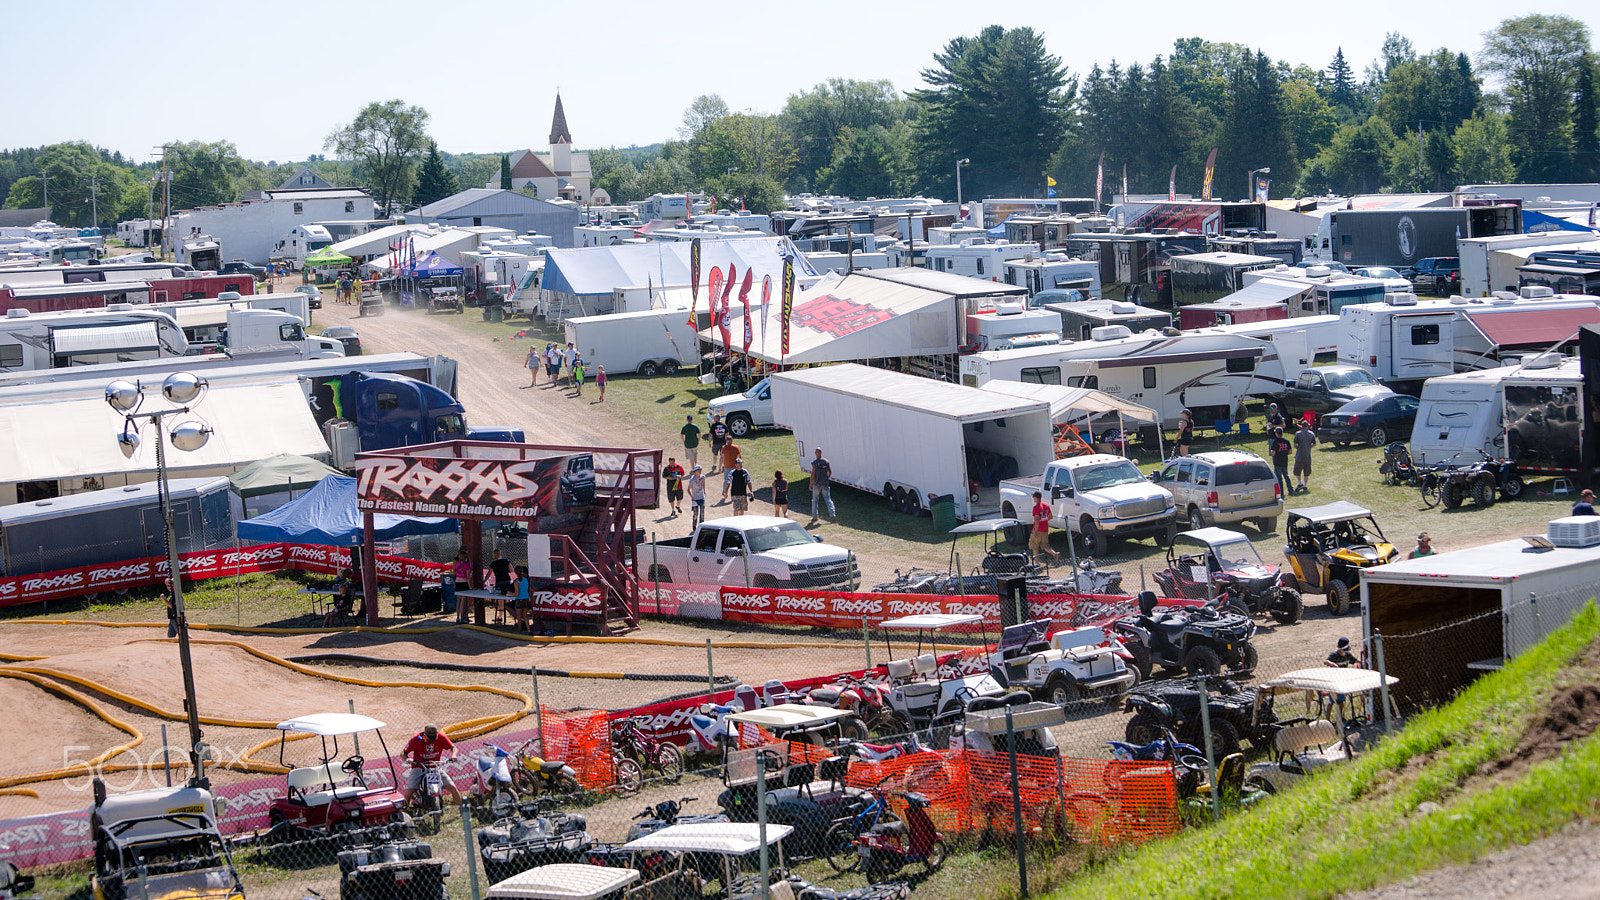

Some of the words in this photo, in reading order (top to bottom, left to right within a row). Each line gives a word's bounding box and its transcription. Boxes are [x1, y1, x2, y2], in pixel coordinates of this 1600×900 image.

[1101, 384, 1120, 392] Laredo
[356, 457, 540, 504] TRAXXAS
[357, 498, 374, 509] The
[375, 500, 414, 511] Fastest
[415, 502, 446, 513] Name
[447, 503, 459, 514] In
[460, 504, 493, 515] Radio
[494, 505, 539, 517] Control
[222, 547, 284, 565] TRAXXAS
[289, 546, 327, 561] TRAXXAS
[88, 562, 150, 582] TRAXXAS
[405, 565, 442, 580] TRAXXAS
[22, 572, 84, 592] TRAXXAS
[532, 590, 602, 608] TRAXXAS
[722, 592, 771, 609] TRAXXAS
[774, 595, 827, 611] TRAXXAS
[830, 598, 883, 614] TRAXXAS
[887, 600, 942, 615] TRAXXAS
